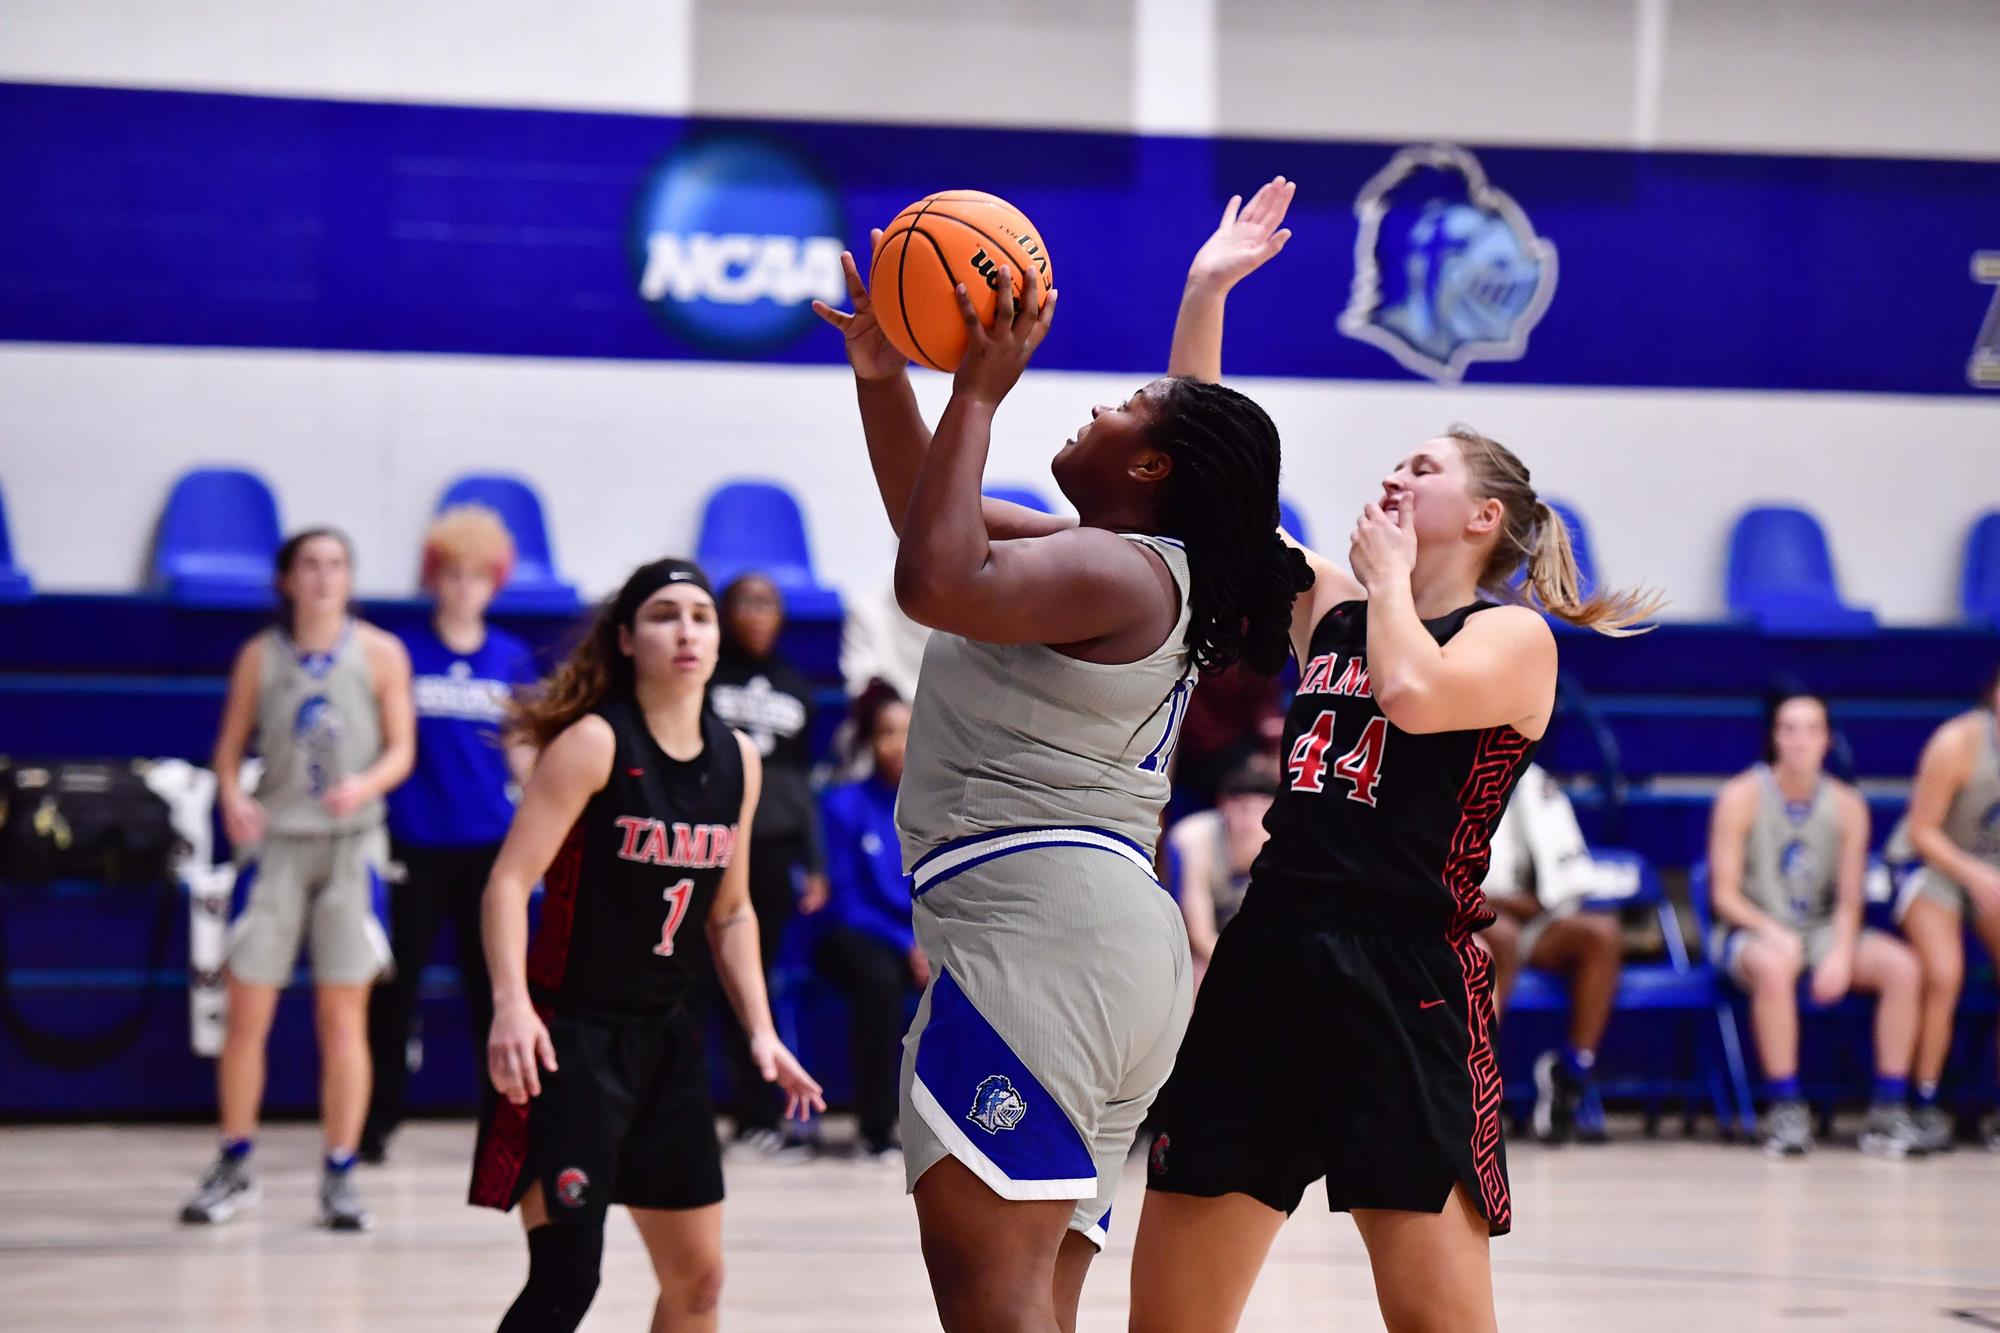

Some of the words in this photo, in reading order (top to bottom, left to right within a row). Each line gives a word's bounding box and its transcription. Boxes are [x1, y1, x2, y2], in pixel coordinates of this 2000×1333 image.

[640, 231, 847, 306] NCAA
[1296, 652, 1373, 698] TAM
[1288, 709, 1388, 808] 44
[652, 878, 695, 957] 1
